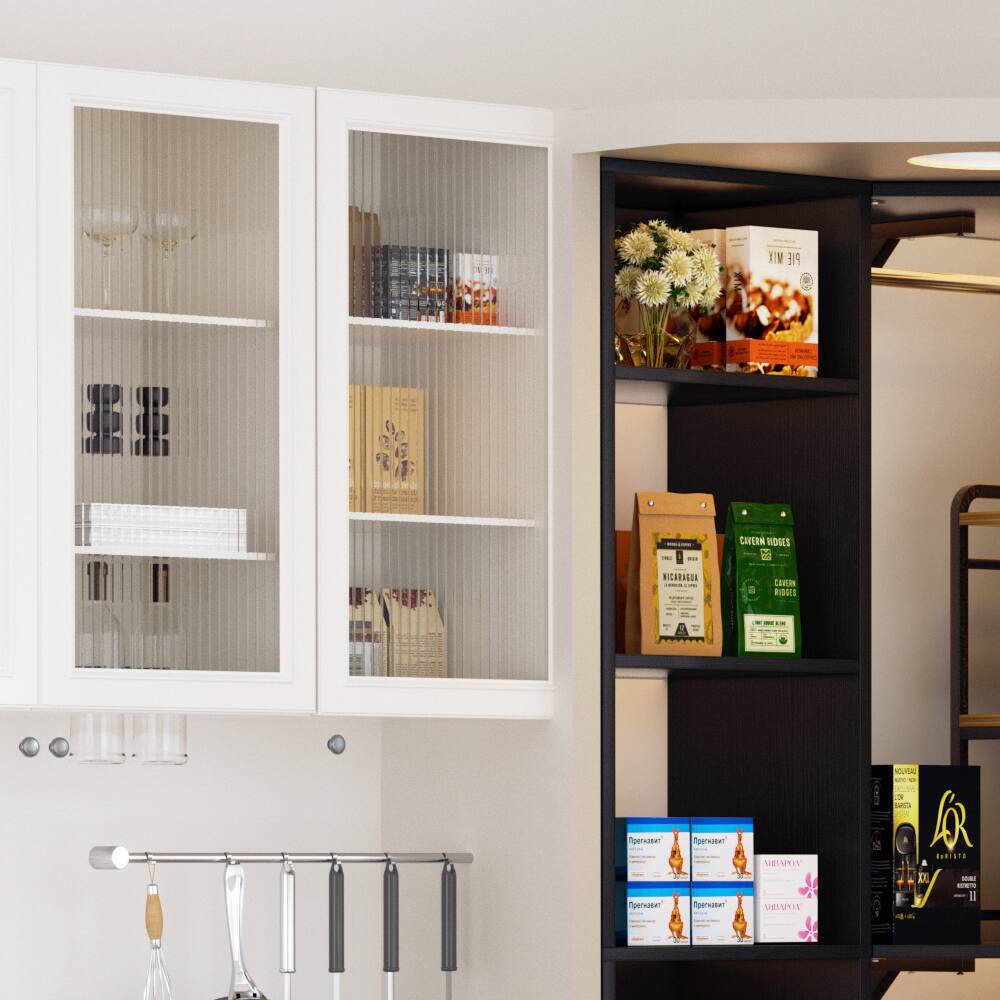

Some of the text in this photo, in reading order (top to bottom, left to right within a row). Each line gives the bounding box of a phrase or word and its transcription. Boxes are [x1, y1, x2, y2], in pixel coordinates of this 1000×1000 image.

[739, 535, 791, 547] CAVERN RIDGES
[662, 573, 699, 582] NICARAGUA
[774, 578, 797, 588] CAVERN
[774, 588, 797, 597] RIDGES
[895, 767, 917, 775] NOUVEAU
[628, 836, 662, 845] Прегнавит
[693, 836, 725, 846] Прегнавит
[628, 901, 662, 910] Прегнавит
[693, 900, 726, 909] Прегнавит
